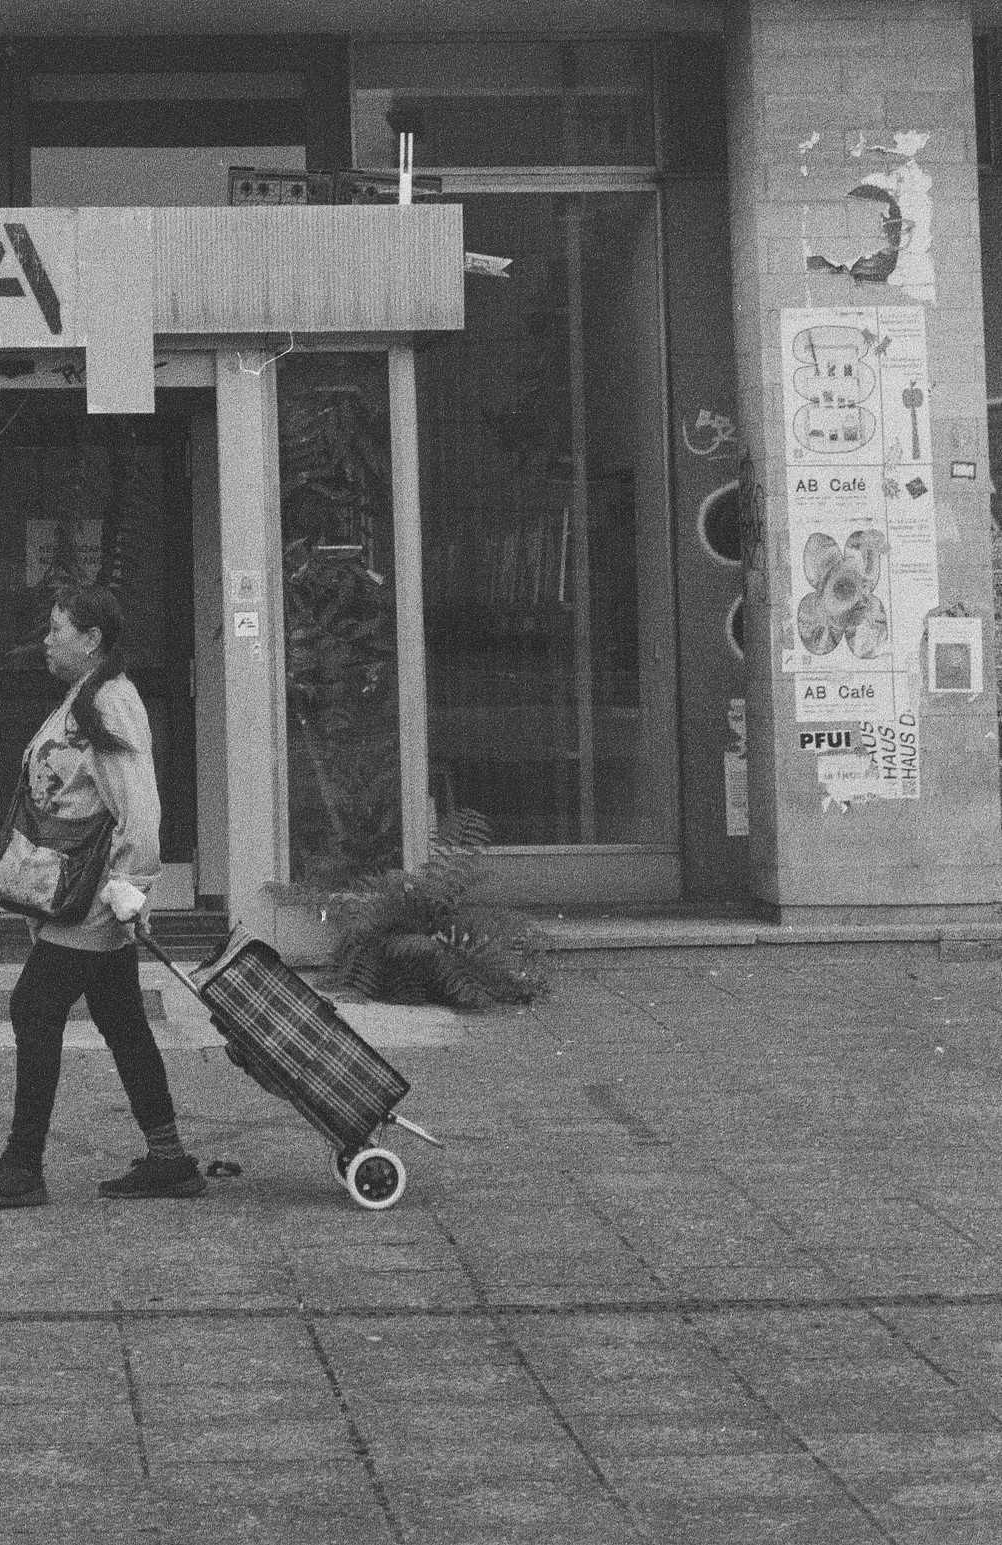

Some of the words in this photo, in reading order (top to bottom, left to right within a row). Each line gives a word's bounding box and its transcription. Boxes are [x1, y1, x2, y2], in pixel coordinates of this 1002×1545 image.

[796, 478, 818, 492] AB
[829, 477, 866, 492] Café
[804, 685, 827, 699] AB
[838, 684, 875, 698] Café
[799, 732, 851, 749] PFUI
[878, 726, 897, 779] HAUS
[899, 732, 917, 779] HAUS
